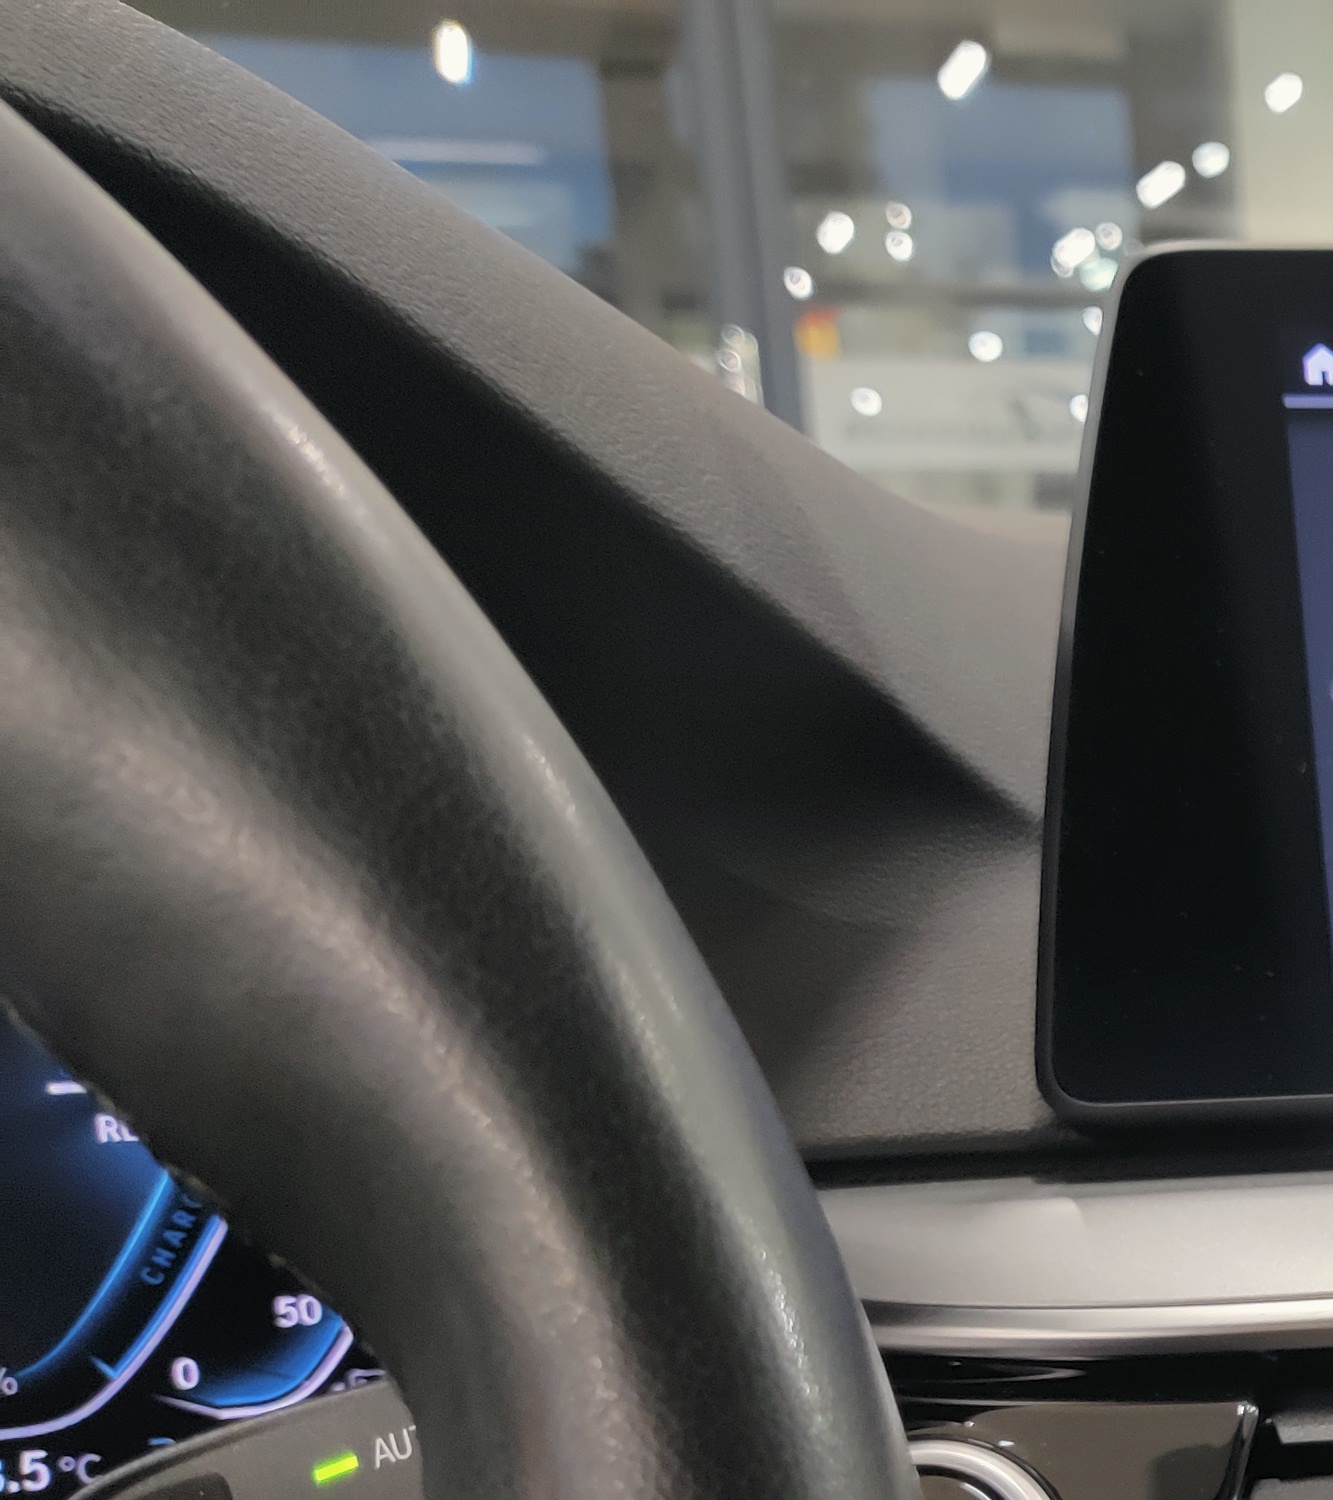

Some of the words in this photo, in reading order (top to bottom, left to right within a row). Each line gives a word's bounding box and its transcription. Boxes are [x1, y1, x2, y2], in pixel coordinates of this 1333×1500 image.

[271, 1293, 323, 1329] 50
[170, 1356, 200, 1391] 0
[373, 1424, 418, 1470] AU
